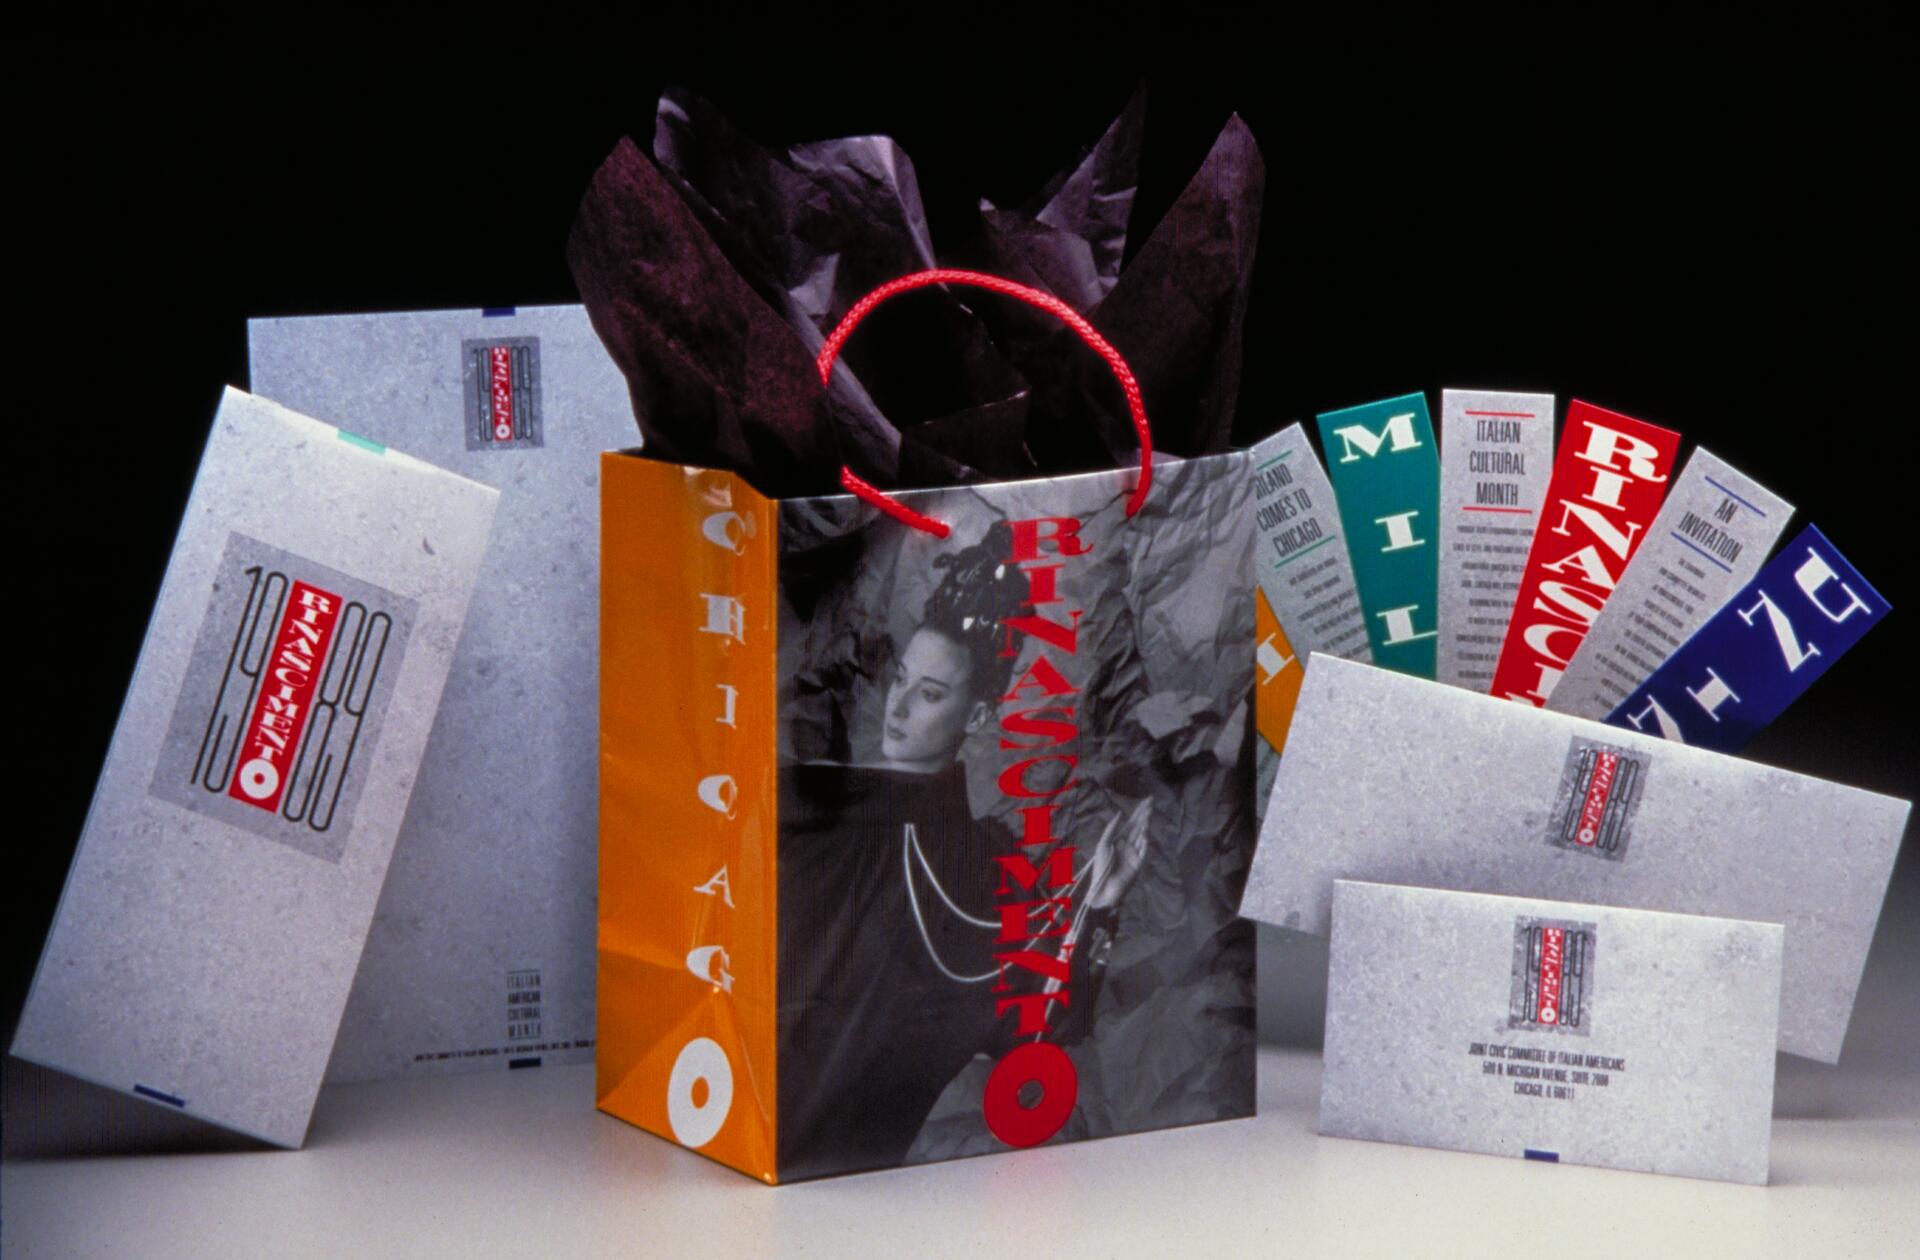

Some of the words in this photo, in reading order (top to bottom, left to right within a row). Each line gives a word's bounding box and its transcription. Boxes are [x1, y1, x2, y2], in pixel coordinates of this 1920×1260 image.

[1476, 420, 1521, 443] ITALIAN
[1469, 450, 1526, 475] CULTURAL
[1256, 494, 1298, 532] COMES
[1294, 487, 1313, 512] TO
[1476, 482, 1518, 505] MONTH
[1714, 498, 1738, 524] AN
[1272, 517, 1323, 557] CHICAGO
[1678, 511, 1743, 563] INVITATION
[238, 588, 333, 800] RINASCIMENTO
[667, 511, 747, 1148] CHICAGO
[983, 517, 1093, 1149] RINASCIMENTO
[1507, 1064, 1540, 1079] MICHIGAN
[1548, 1051, 1556, 1063] OF
[1558, 1050, 1584, 1067] ITALIAN
[1585, 1054, 1625, 1071] AMERICANS
